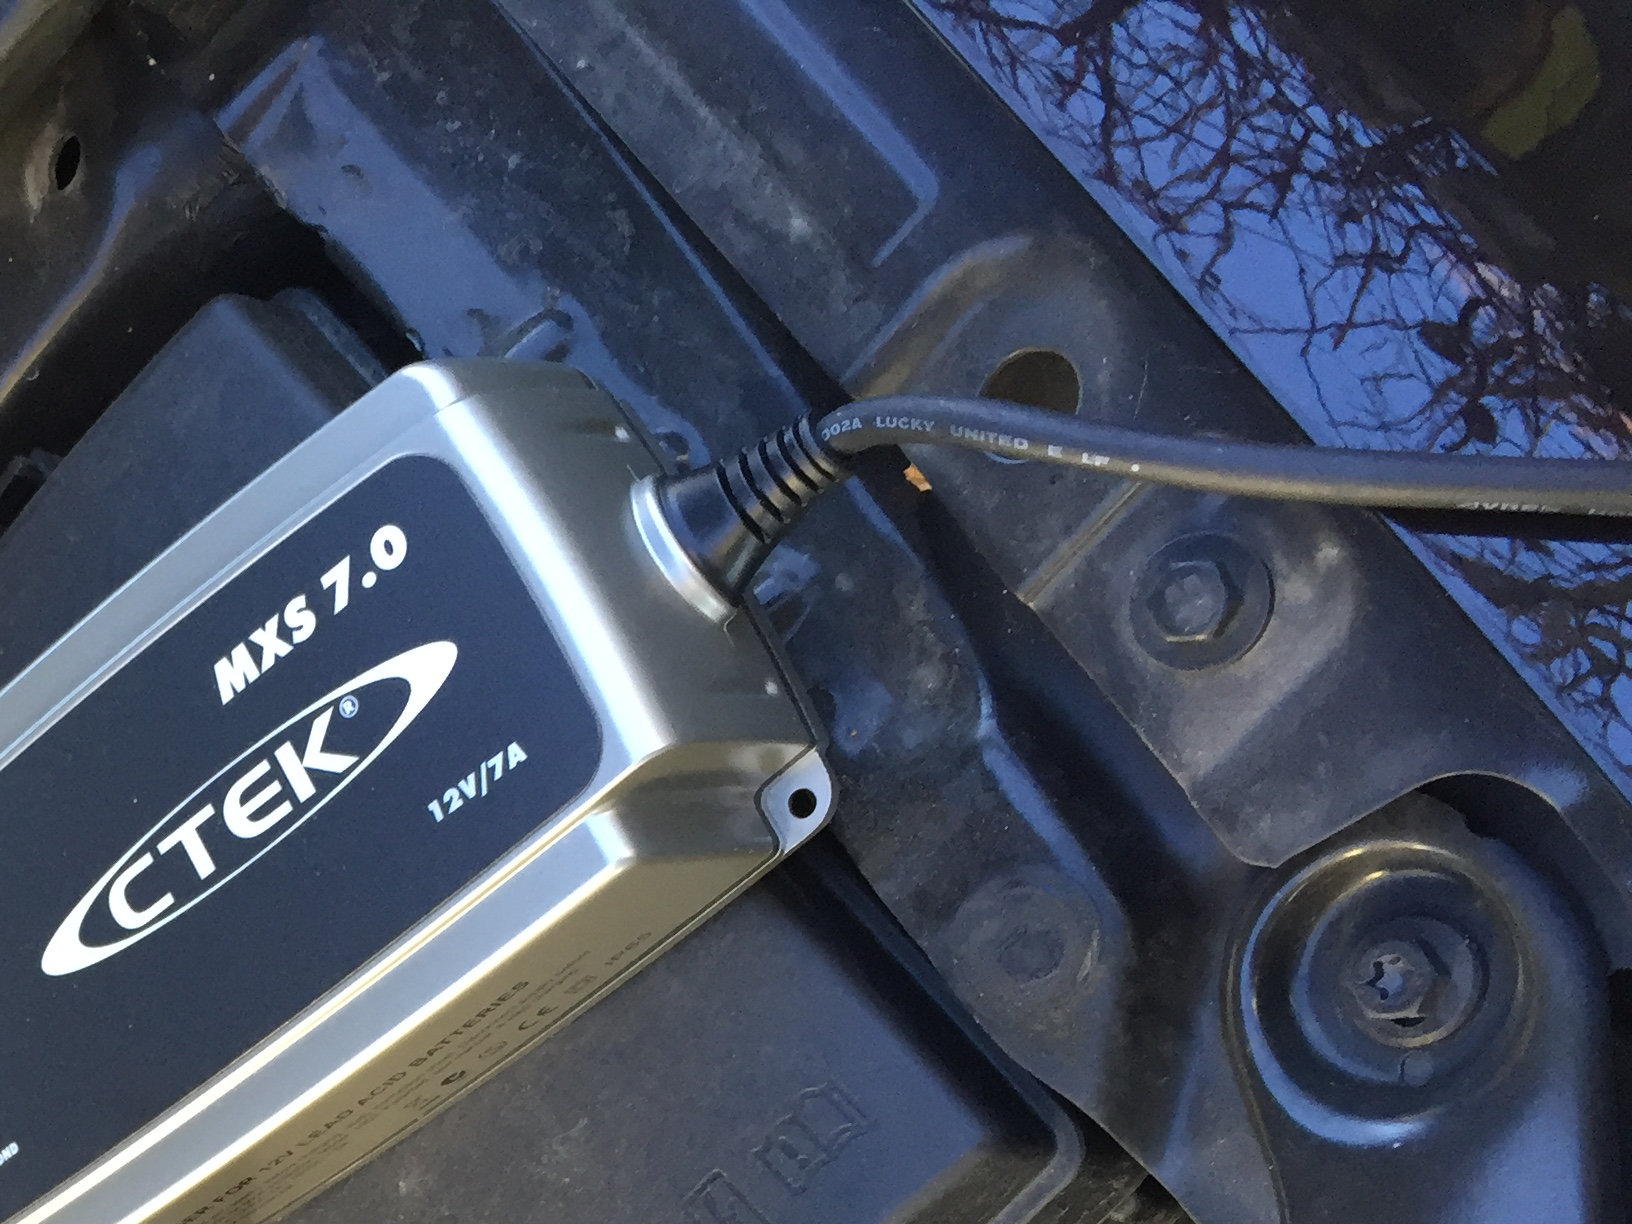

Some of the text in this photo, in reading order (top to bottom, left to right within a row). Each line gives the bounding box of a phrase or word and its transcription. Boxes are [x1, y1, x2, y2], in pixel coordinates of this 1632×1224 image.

[876, 416, 935, 432] LUCKY
[950, 424, 1029, 451] UNITED
[213, 524, 407, 706] MXS 7.0
[428, 741, 528, 823] 12V/7A
[212, 1174, 259, 1204] FOR
[258, 1149, 294, 1173] 12V
[295, 1108, 354, 1148] LEAD
[357, 1070, 407, 1107] ACID
[408, 980, 530, 1069] BATTERIES
